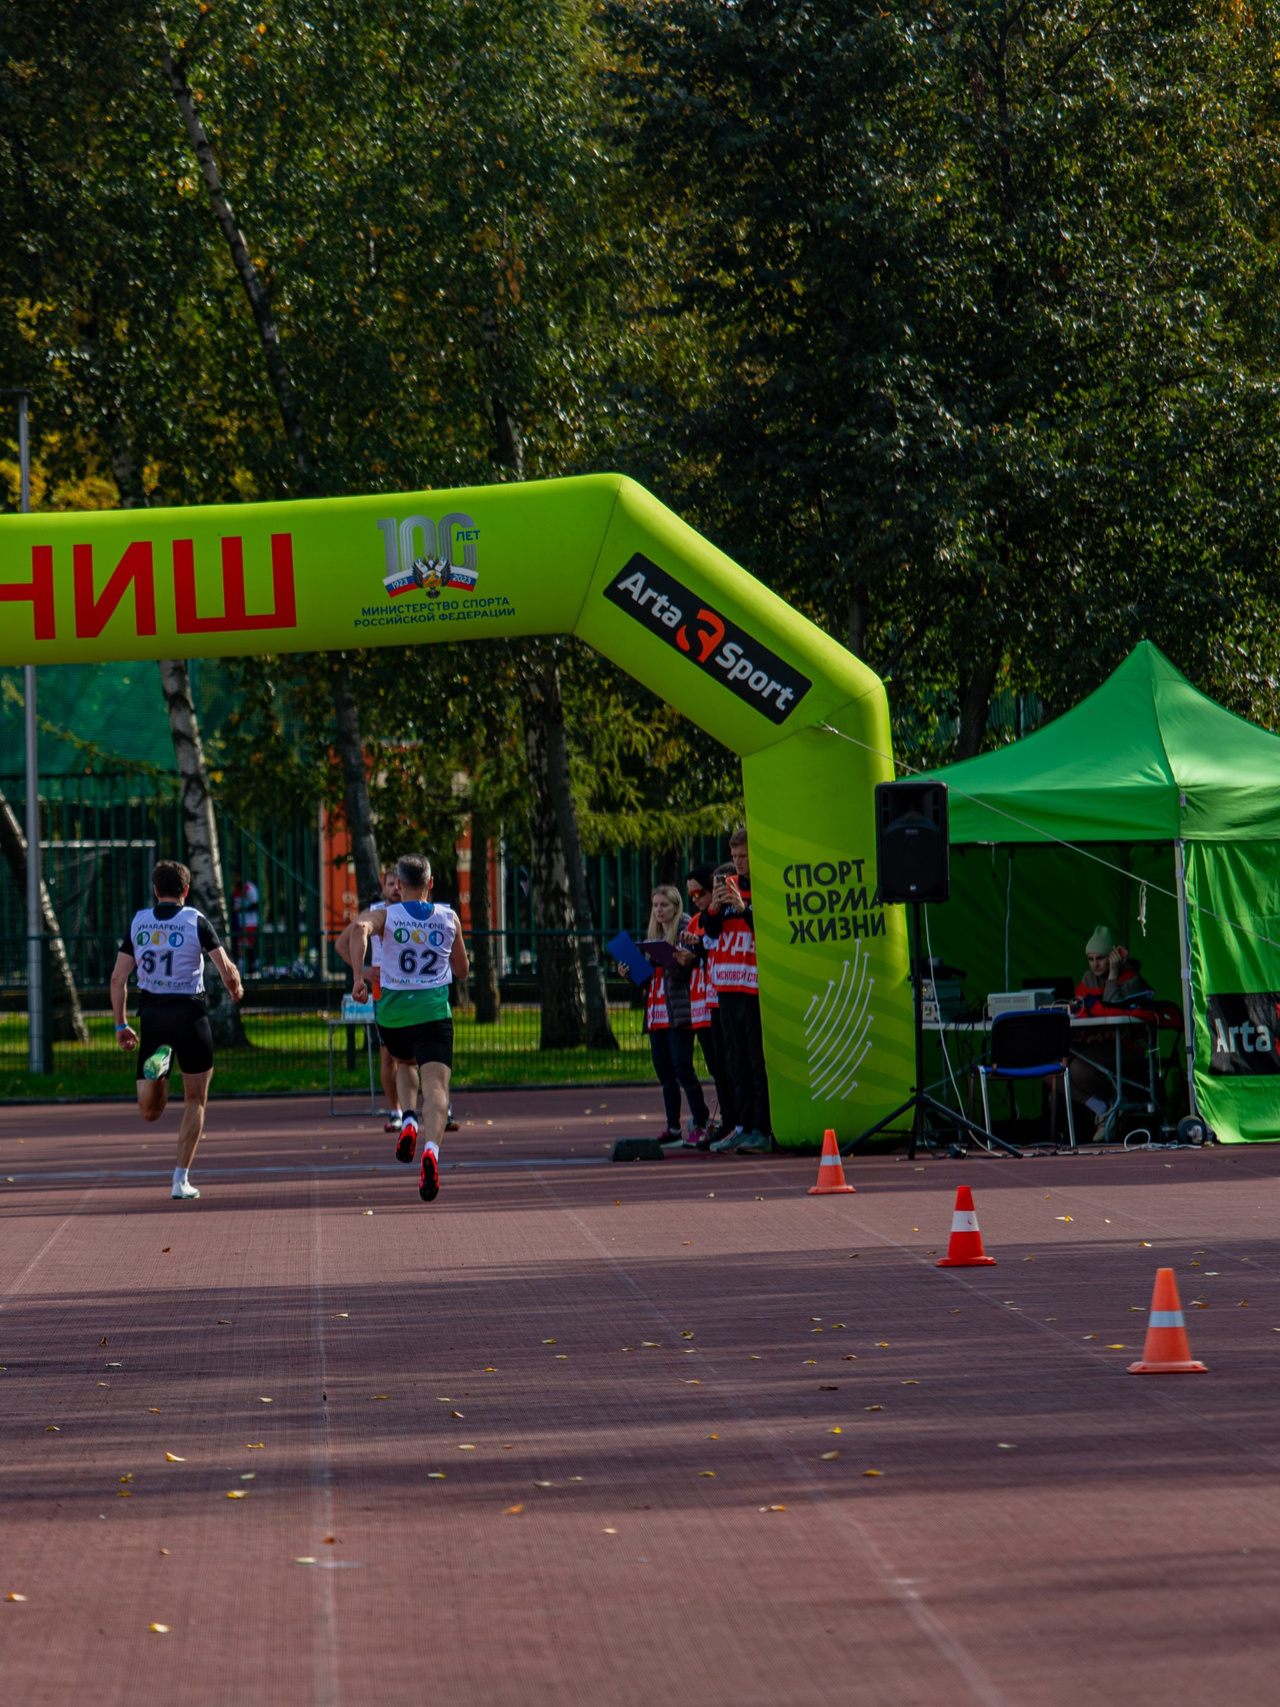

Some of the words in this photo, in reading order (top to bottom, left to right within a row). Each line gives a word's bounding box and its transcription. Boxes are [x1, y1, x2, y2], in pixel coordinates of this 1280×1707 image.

[456, 530, 480, 541] ЛЕТ
[391, 577, 409, 590] 1923
[452, 573, 472, 585] 2023
[353, 611, 435, 628] РОССИЙСКОЙ
[438, 607, 516, 621] ФЕДЕРАЦИИ
[361, 600, 459, 617] МИНИСТЕРСТВО
[462, 596, 510, 609] СПОРТА
[616, 571, 683, 629] Arta
[714, 641, 795, 711] Sport
[783, 858, 866, 890] СПОРТ
[785, 885, 885, 918] НОРМА
[394, 921, 445, 930] VMARAFONE
[789, 911, 887, 945] ЖИЗНИ
[141, 949, 175, 978] 61
[398, 948, 439, 976] 62
[1215, 1018, 1272, 1054] Arta
